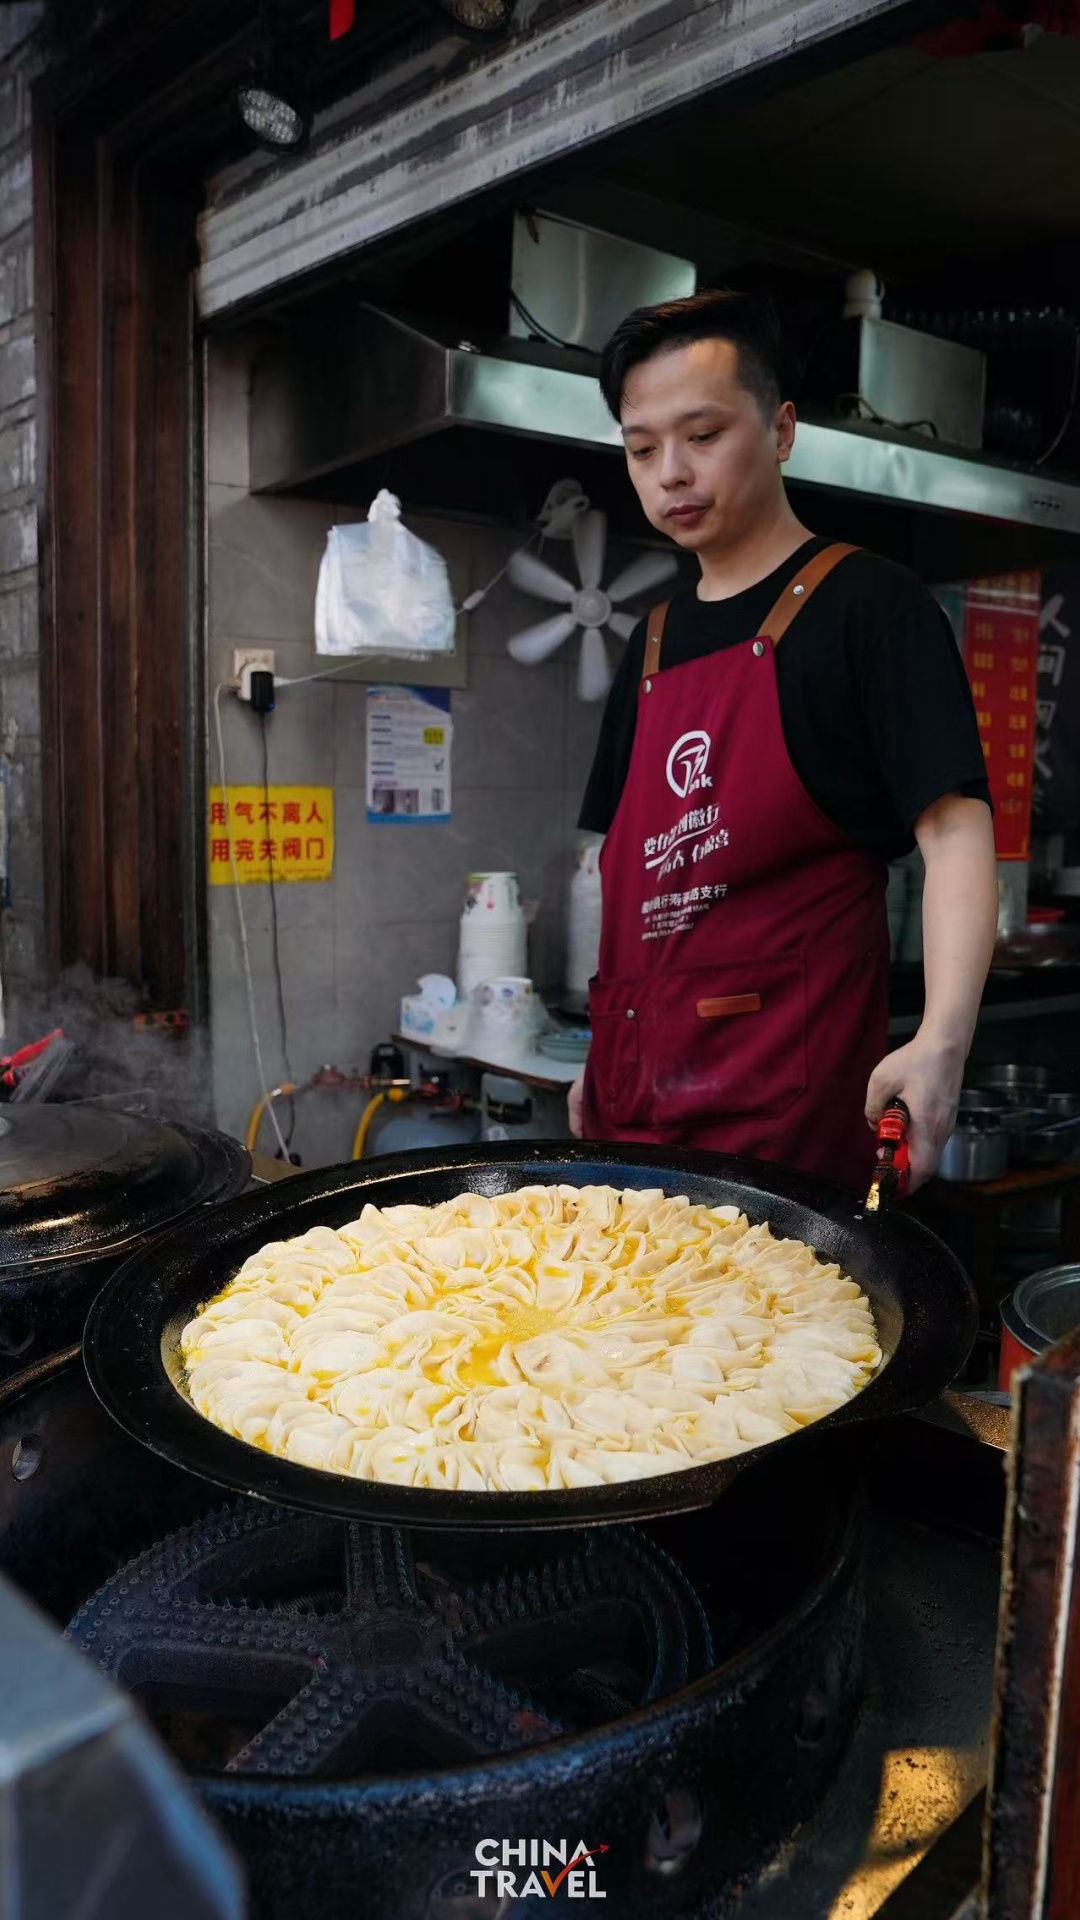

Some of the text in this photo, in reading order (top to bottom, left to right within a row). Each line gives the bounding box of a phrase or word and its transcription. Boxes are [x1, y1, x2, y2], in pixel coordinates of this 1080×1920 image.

[210, 801, 324, 825] 用气不离人
[210, 837, 325, 862] 用完关阀门
